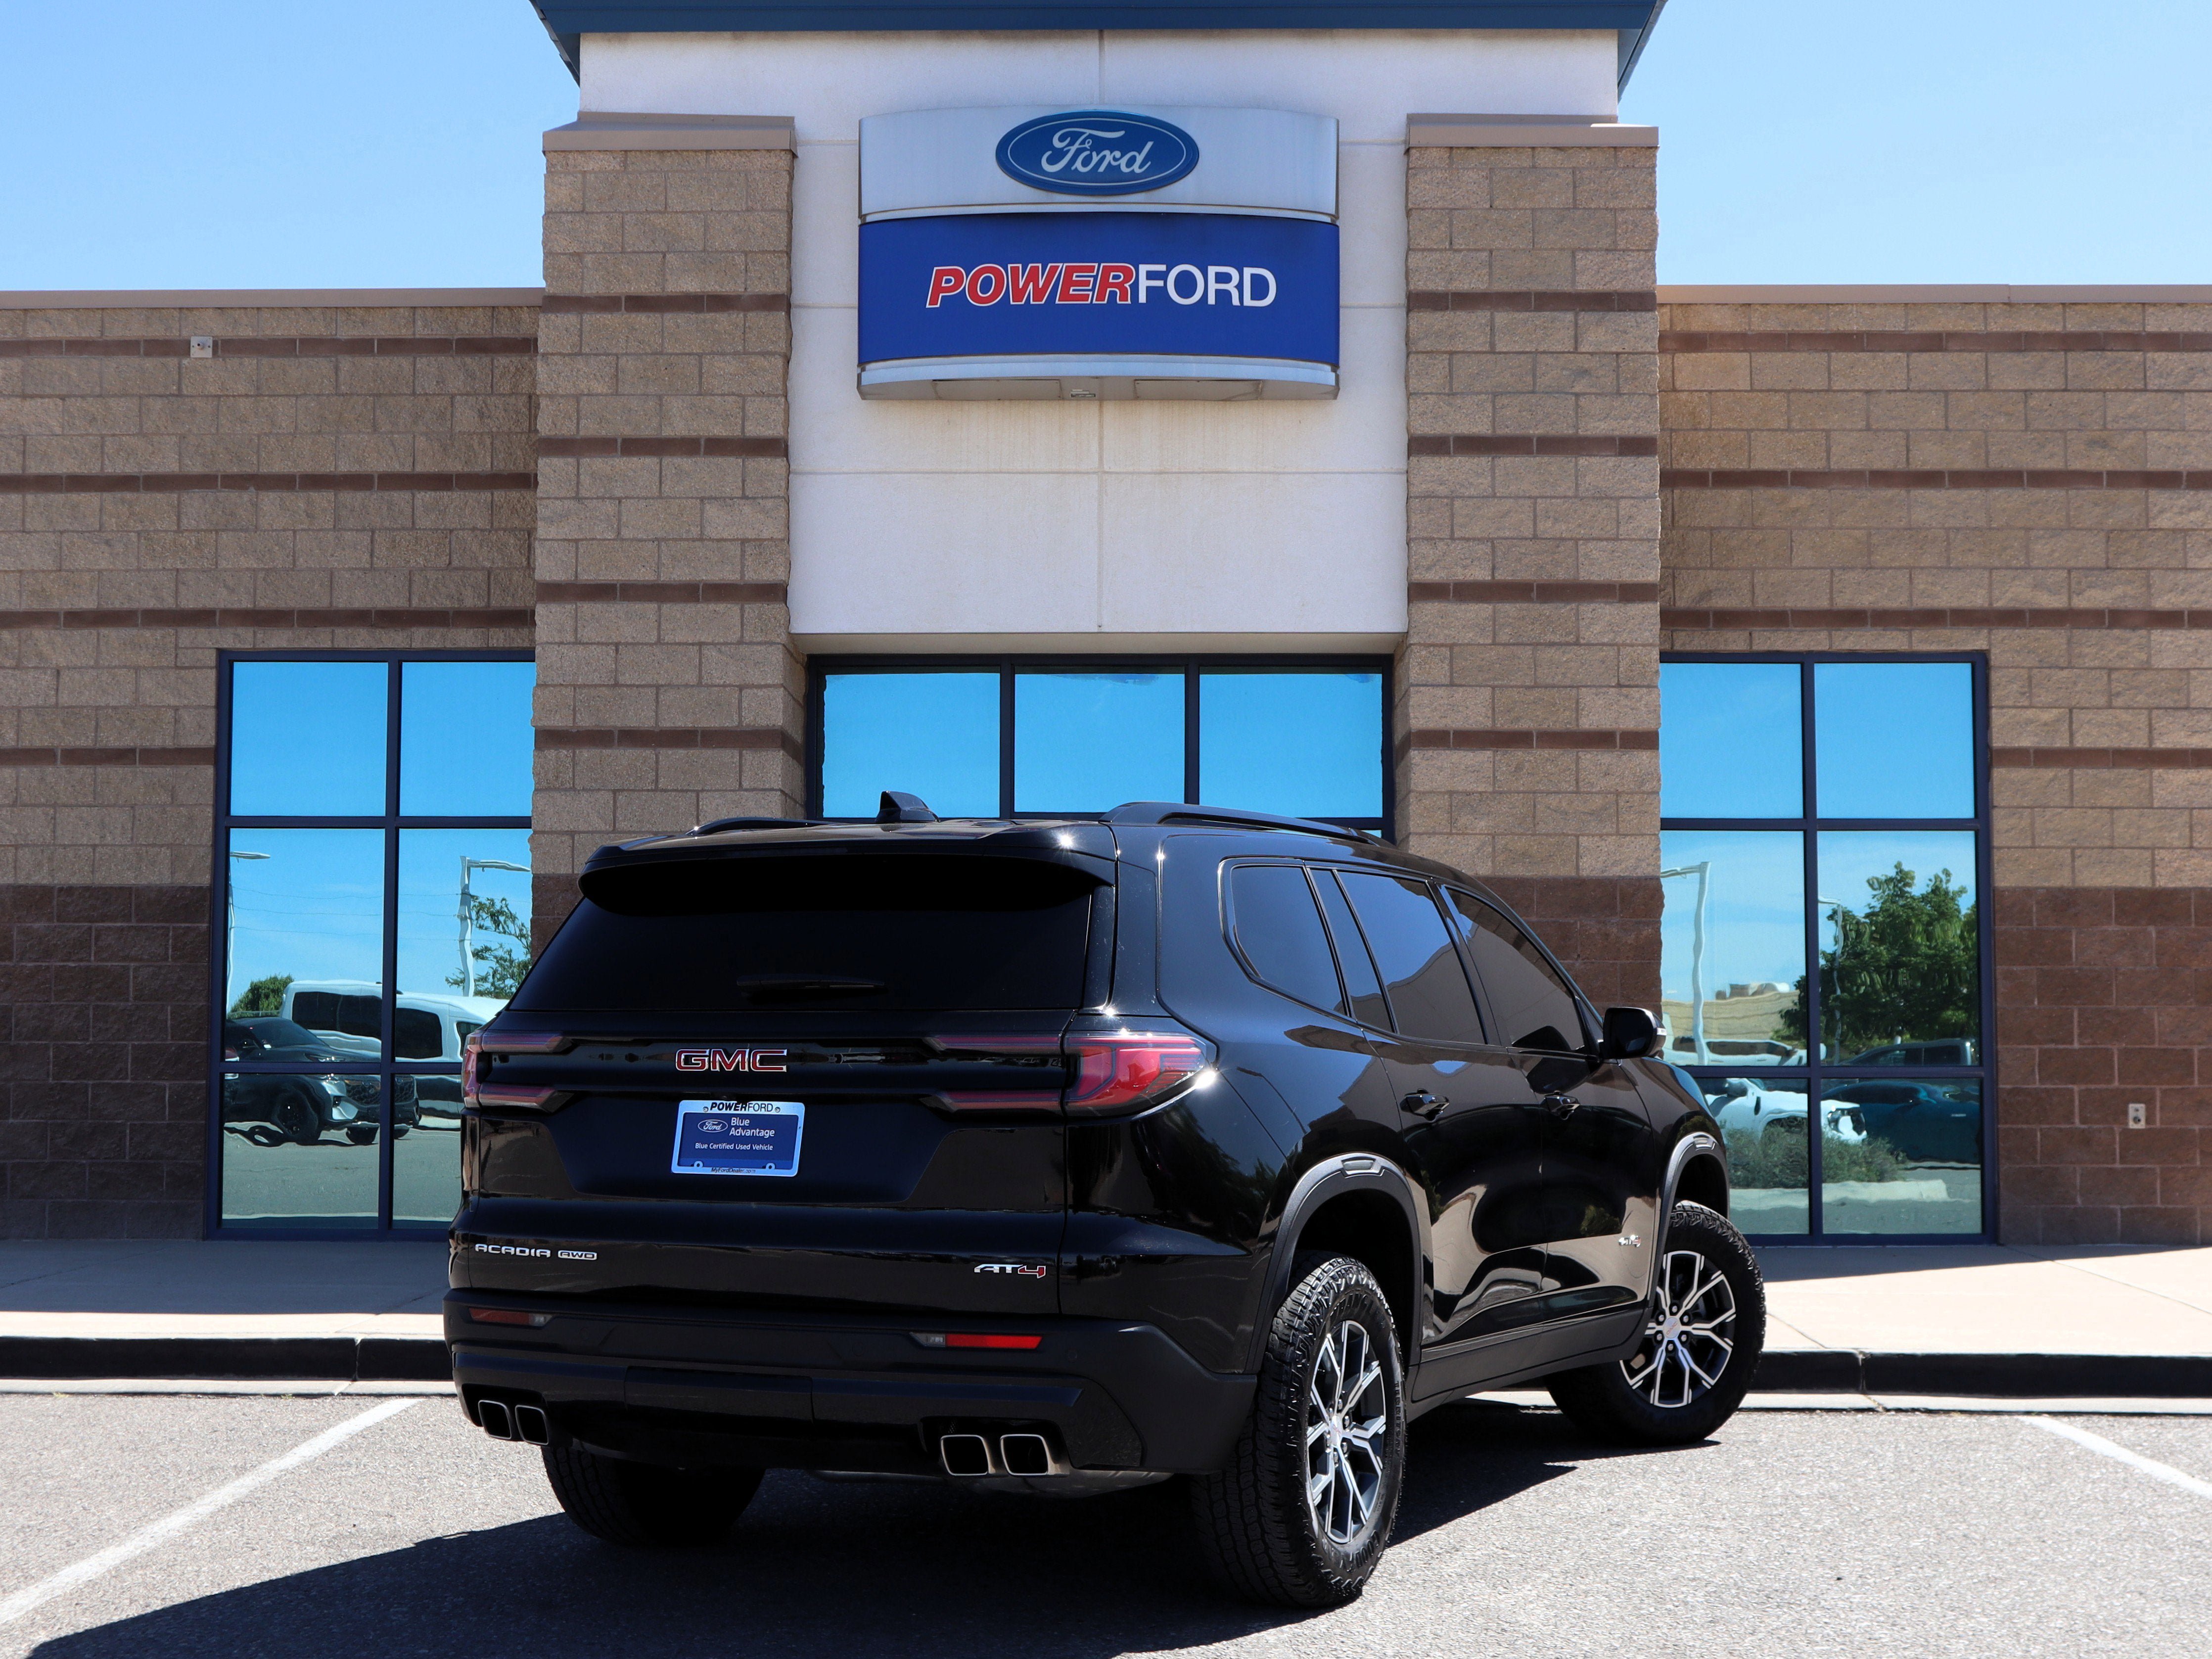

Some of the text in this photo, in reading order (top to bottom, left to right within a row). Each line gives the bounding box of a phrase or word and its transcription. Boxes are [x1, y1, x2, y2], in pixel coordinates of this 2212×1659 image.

[1041, 127, 1153, 173] Ford
[925, 263, 1277, 308] POWERFORD
[676, 1048, 787, 1072] GMC
[710, 1102, 774, 1112] POWERFORD
[703, 1121, 722, 1131] Ford
[731, 1117, 750, 1126] Blue
[729, 1127, 775, 1138] Advantage
[475, 1244, 597, 1260] ACADIA AWD
[974, 1264, 1046, 1279] AT4
